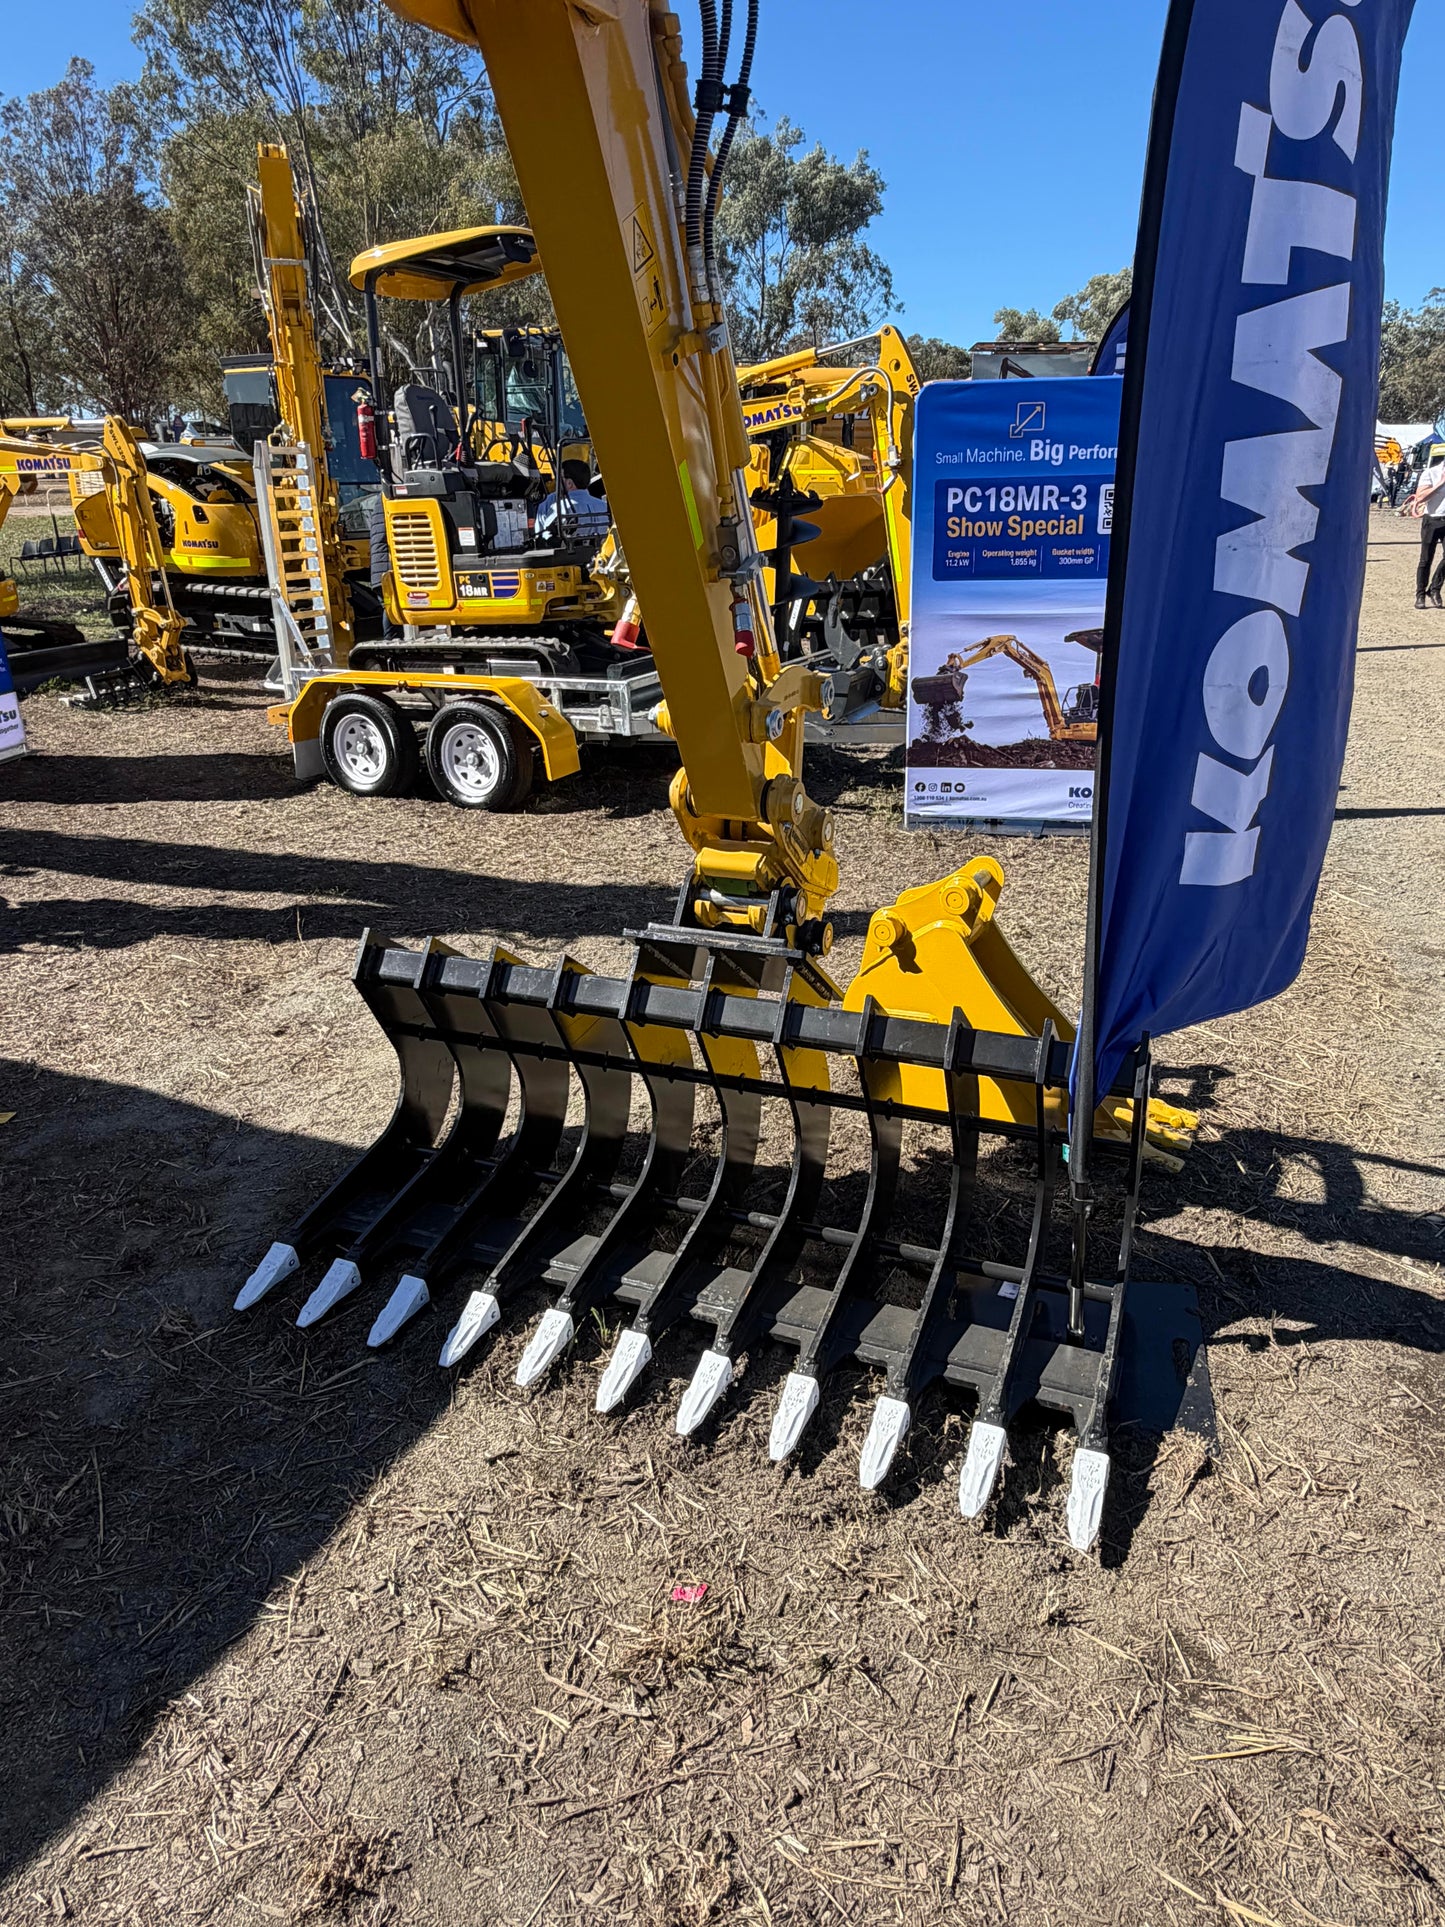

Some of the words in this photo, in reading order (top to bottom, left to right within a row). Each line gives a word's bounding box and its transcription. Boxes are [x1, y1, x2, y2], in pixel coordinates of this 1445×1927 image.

[743, 402, 802, 429] OMATSU
[1179, 0, 1364, 886] KOMATS
[936, 452, 963, 464] Small
[966, 447, 1026, 463] Machine.
[1030, 439, 1064, 466] Big
[16, 454, 72, 471] KOMATSU
[947, 485, 1087, 514] PC18MR-3
[947, 517, 1003, 538] Show
[1008, 515, 1084, 541] Special
[182, 539, 219, 549] KOMATSU
[982, 549, 1014, 559] Operating
[1015, 549, 1037, 558] weight
[1076, 547, 1095, 556] width
[1084, 556, 1095, 565] GP
[459, 575, 471, 585] PC
[460, 585, 488, 597] 18MR
[1068, 786, 1093, 799] KO
[1067, 801, 1092, 809] Creatin
